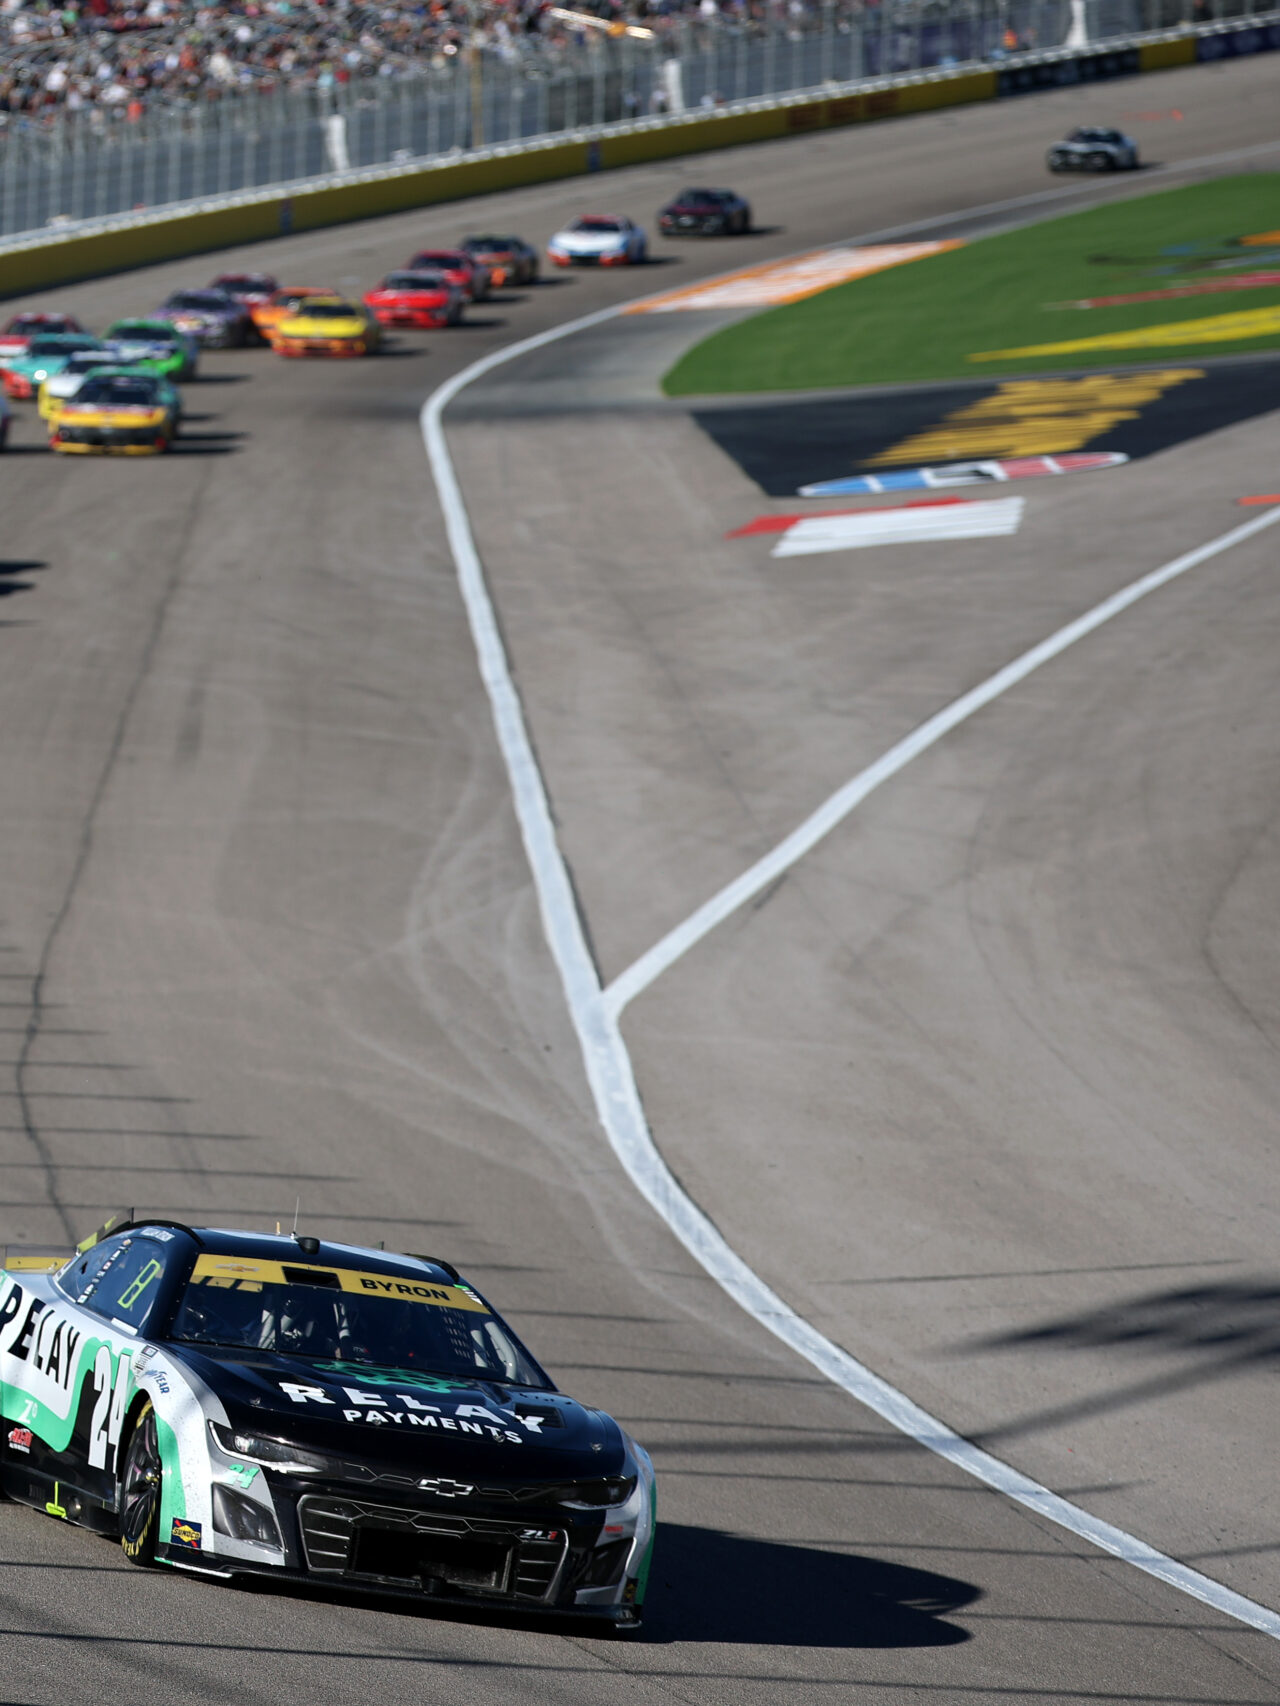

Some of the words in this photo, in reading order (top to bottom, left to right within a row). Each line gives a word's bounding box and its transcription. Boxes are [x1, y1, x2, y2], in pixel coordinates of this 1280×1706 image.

[360, 1278, 450, 1301] BYRON
[88, 1345, 131, 1475] 24
[278, 1382, 545, 1434] RELAY
[342, 1409, 523, 1444] PAYMENTS
[225, 1463, 260, 1489] 24
[172, 1527, 200, 1541] SUNOCO
